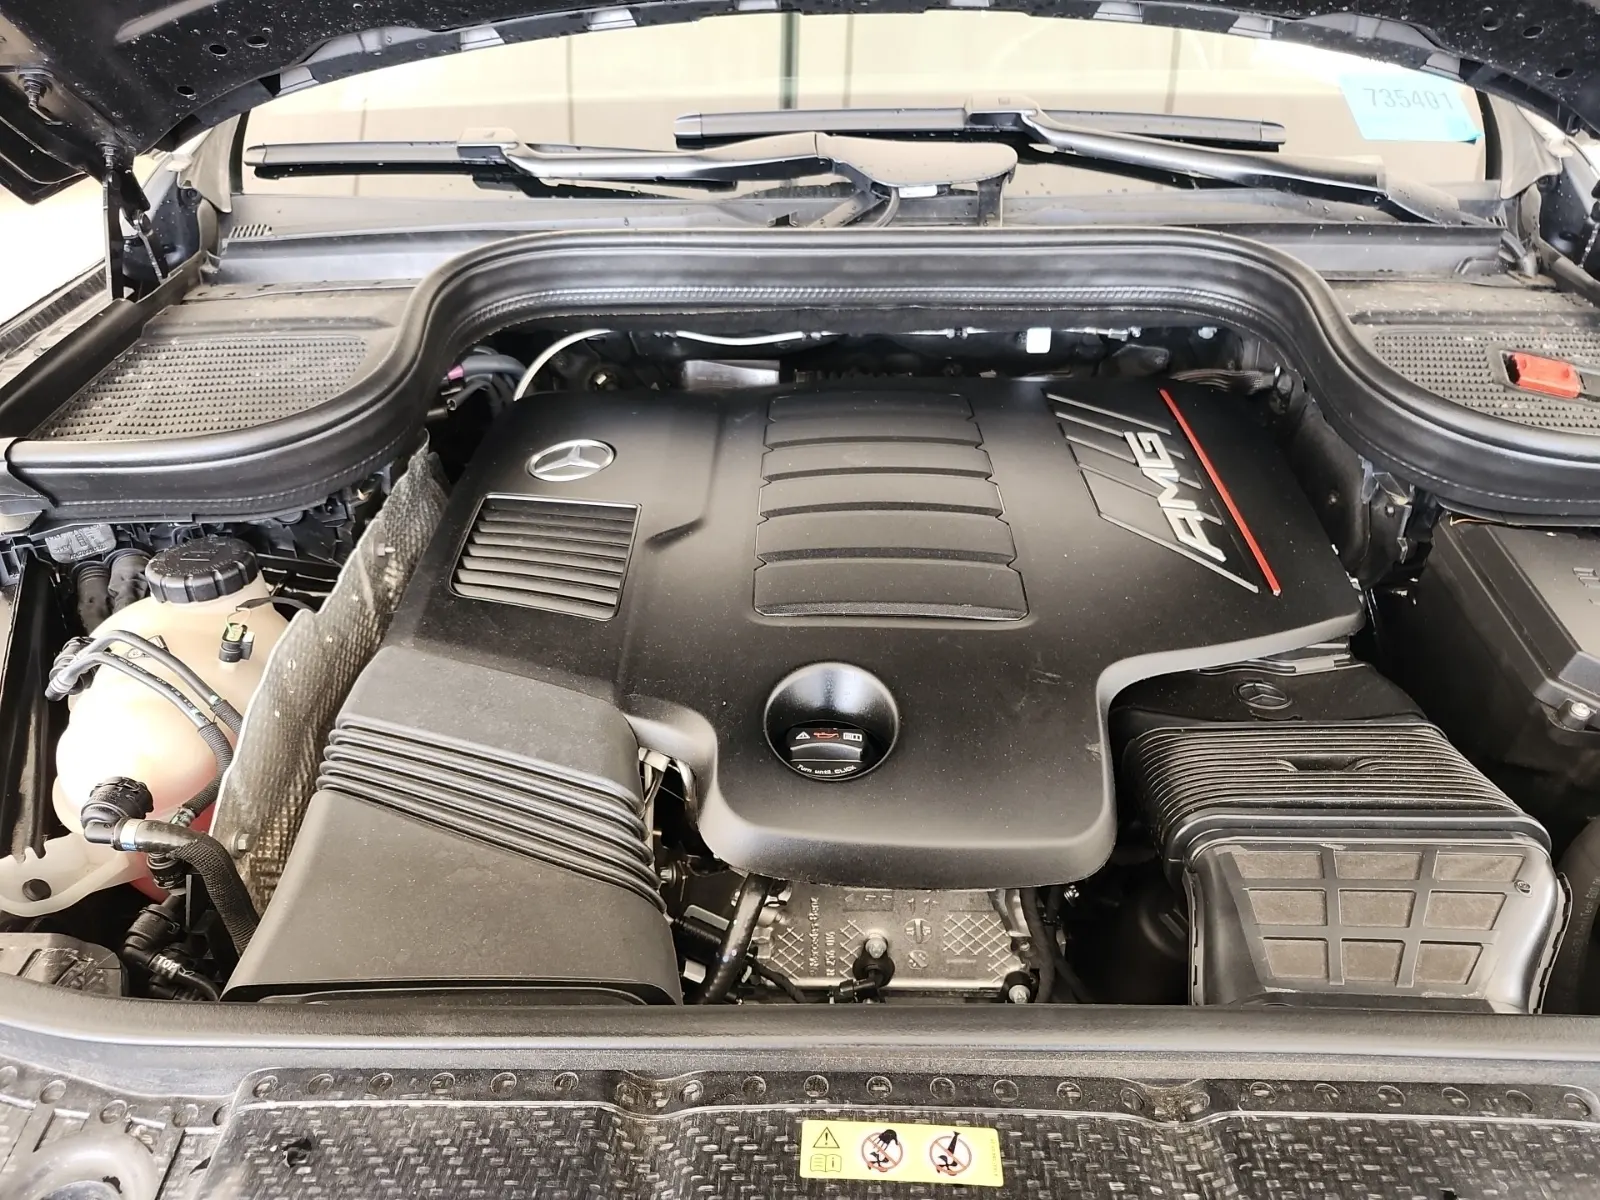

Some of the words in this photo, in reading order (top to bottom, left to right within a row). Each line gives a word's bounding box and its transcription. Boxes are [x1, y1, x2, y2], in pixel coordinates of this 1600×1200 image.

[1363, 87, 1454, 110] 735401
[1123, 431, 1227, 562] AMG
[156, 955, 182, 979] TOP
